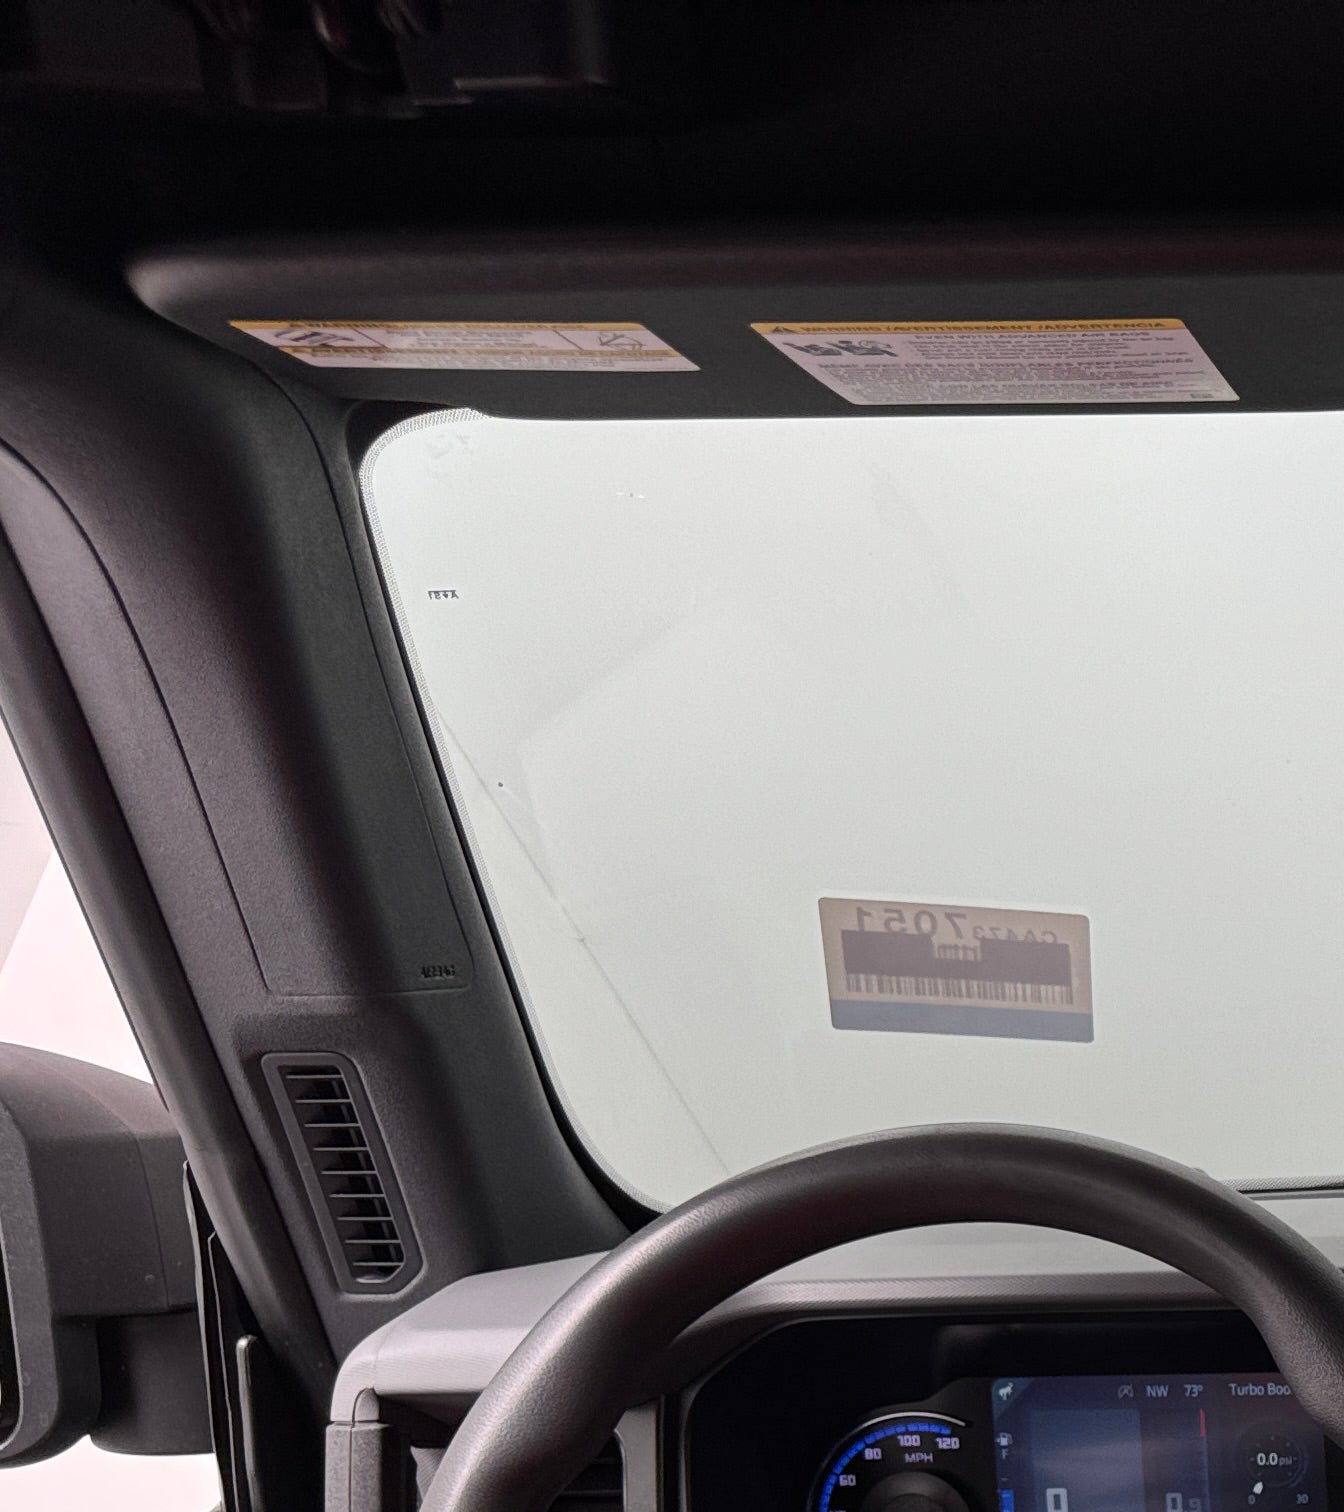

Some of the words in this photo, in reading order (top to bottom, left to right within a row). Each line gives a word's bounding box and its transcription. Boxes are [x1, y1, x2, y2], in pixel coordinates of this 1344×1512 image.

[1145, 1384, 1169, 1398] NW
[1183, 1383, 1204, 1398] 73°
[1228, 1383, 1265, 1397] Turbo
[897, 1434, 922, 1447] 100
[935, 1436, 961, 1450] 120
[864, 1447, 883, 1461] 80
[904, 1452, 935, 1463] MPH
[1256, 1452, 1278, 1466] 0.0
[838, 1474, 857, 1487] 60
